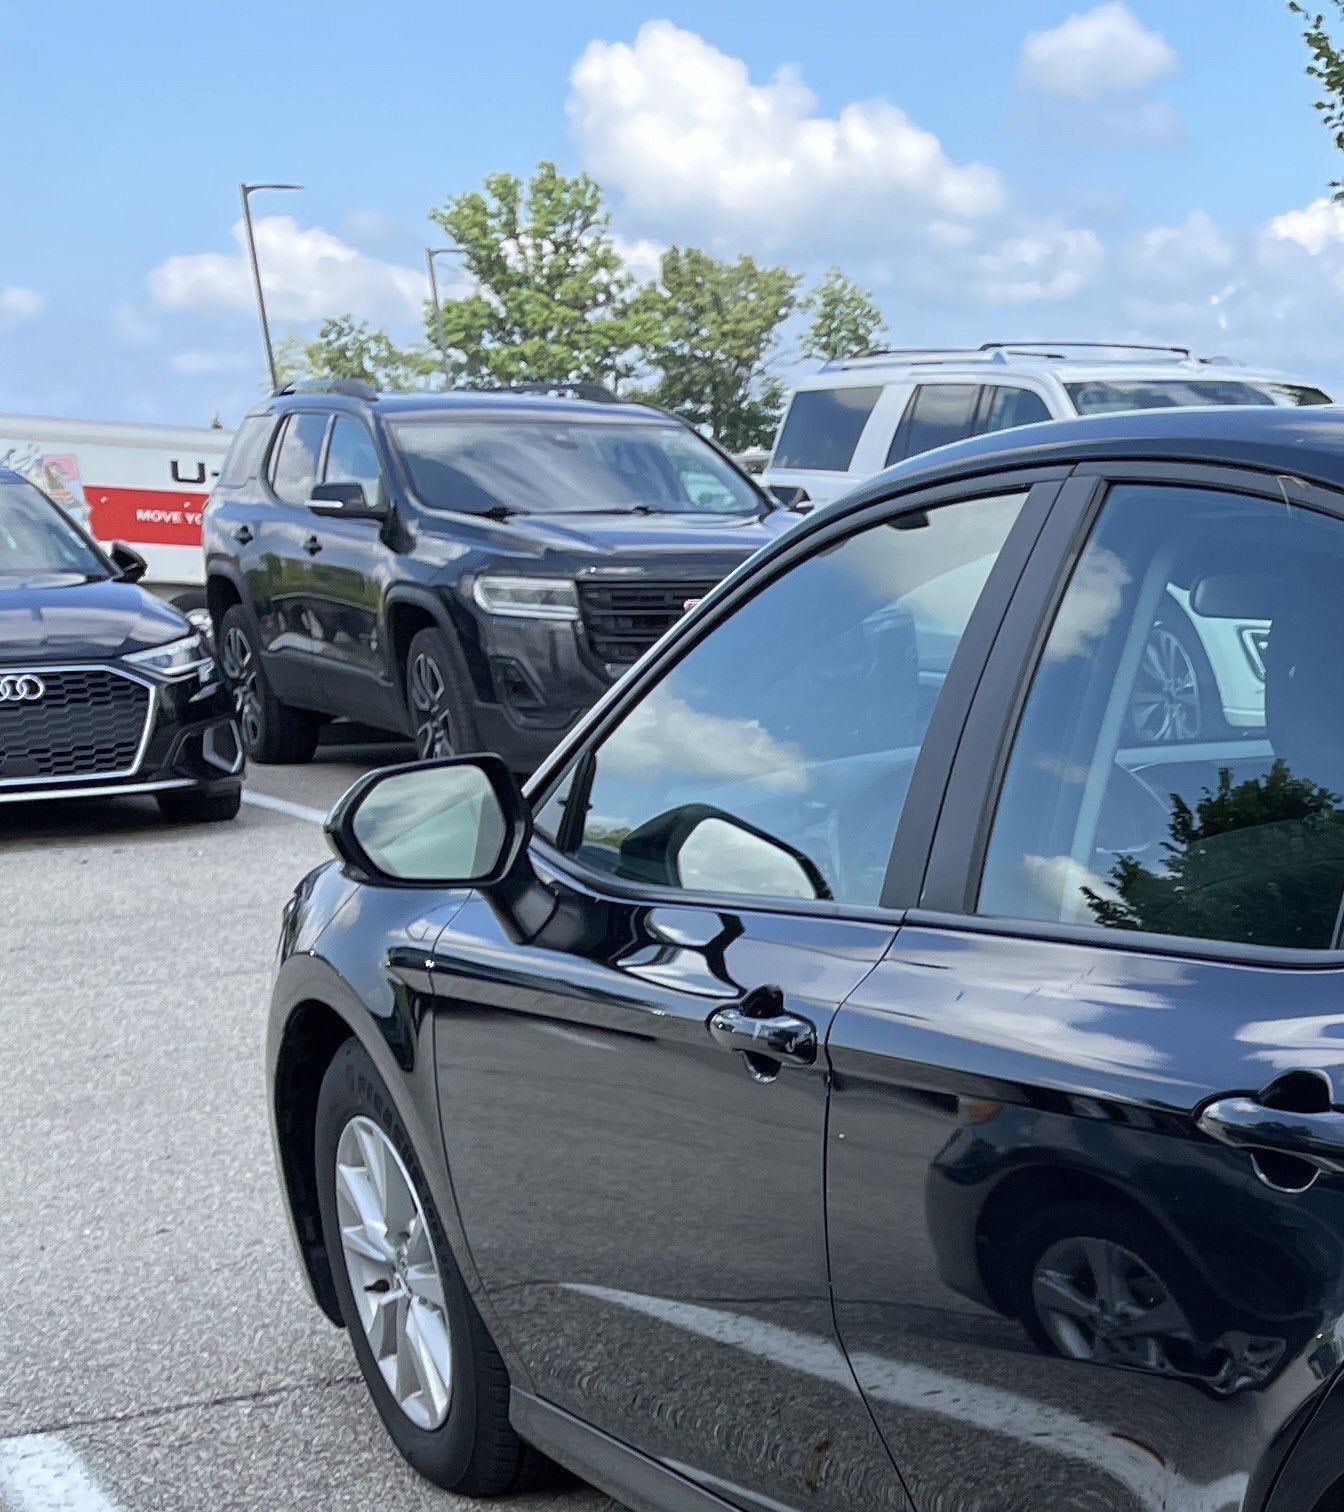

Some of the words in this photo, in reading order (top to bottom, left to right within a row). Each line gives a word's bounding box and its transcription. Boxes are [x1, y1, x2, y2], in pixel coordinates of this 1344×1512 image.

[170, 460, 220, 484] U-
[136, 509, 181, 525] MOVE
[185, 512, 203, 526] YO
